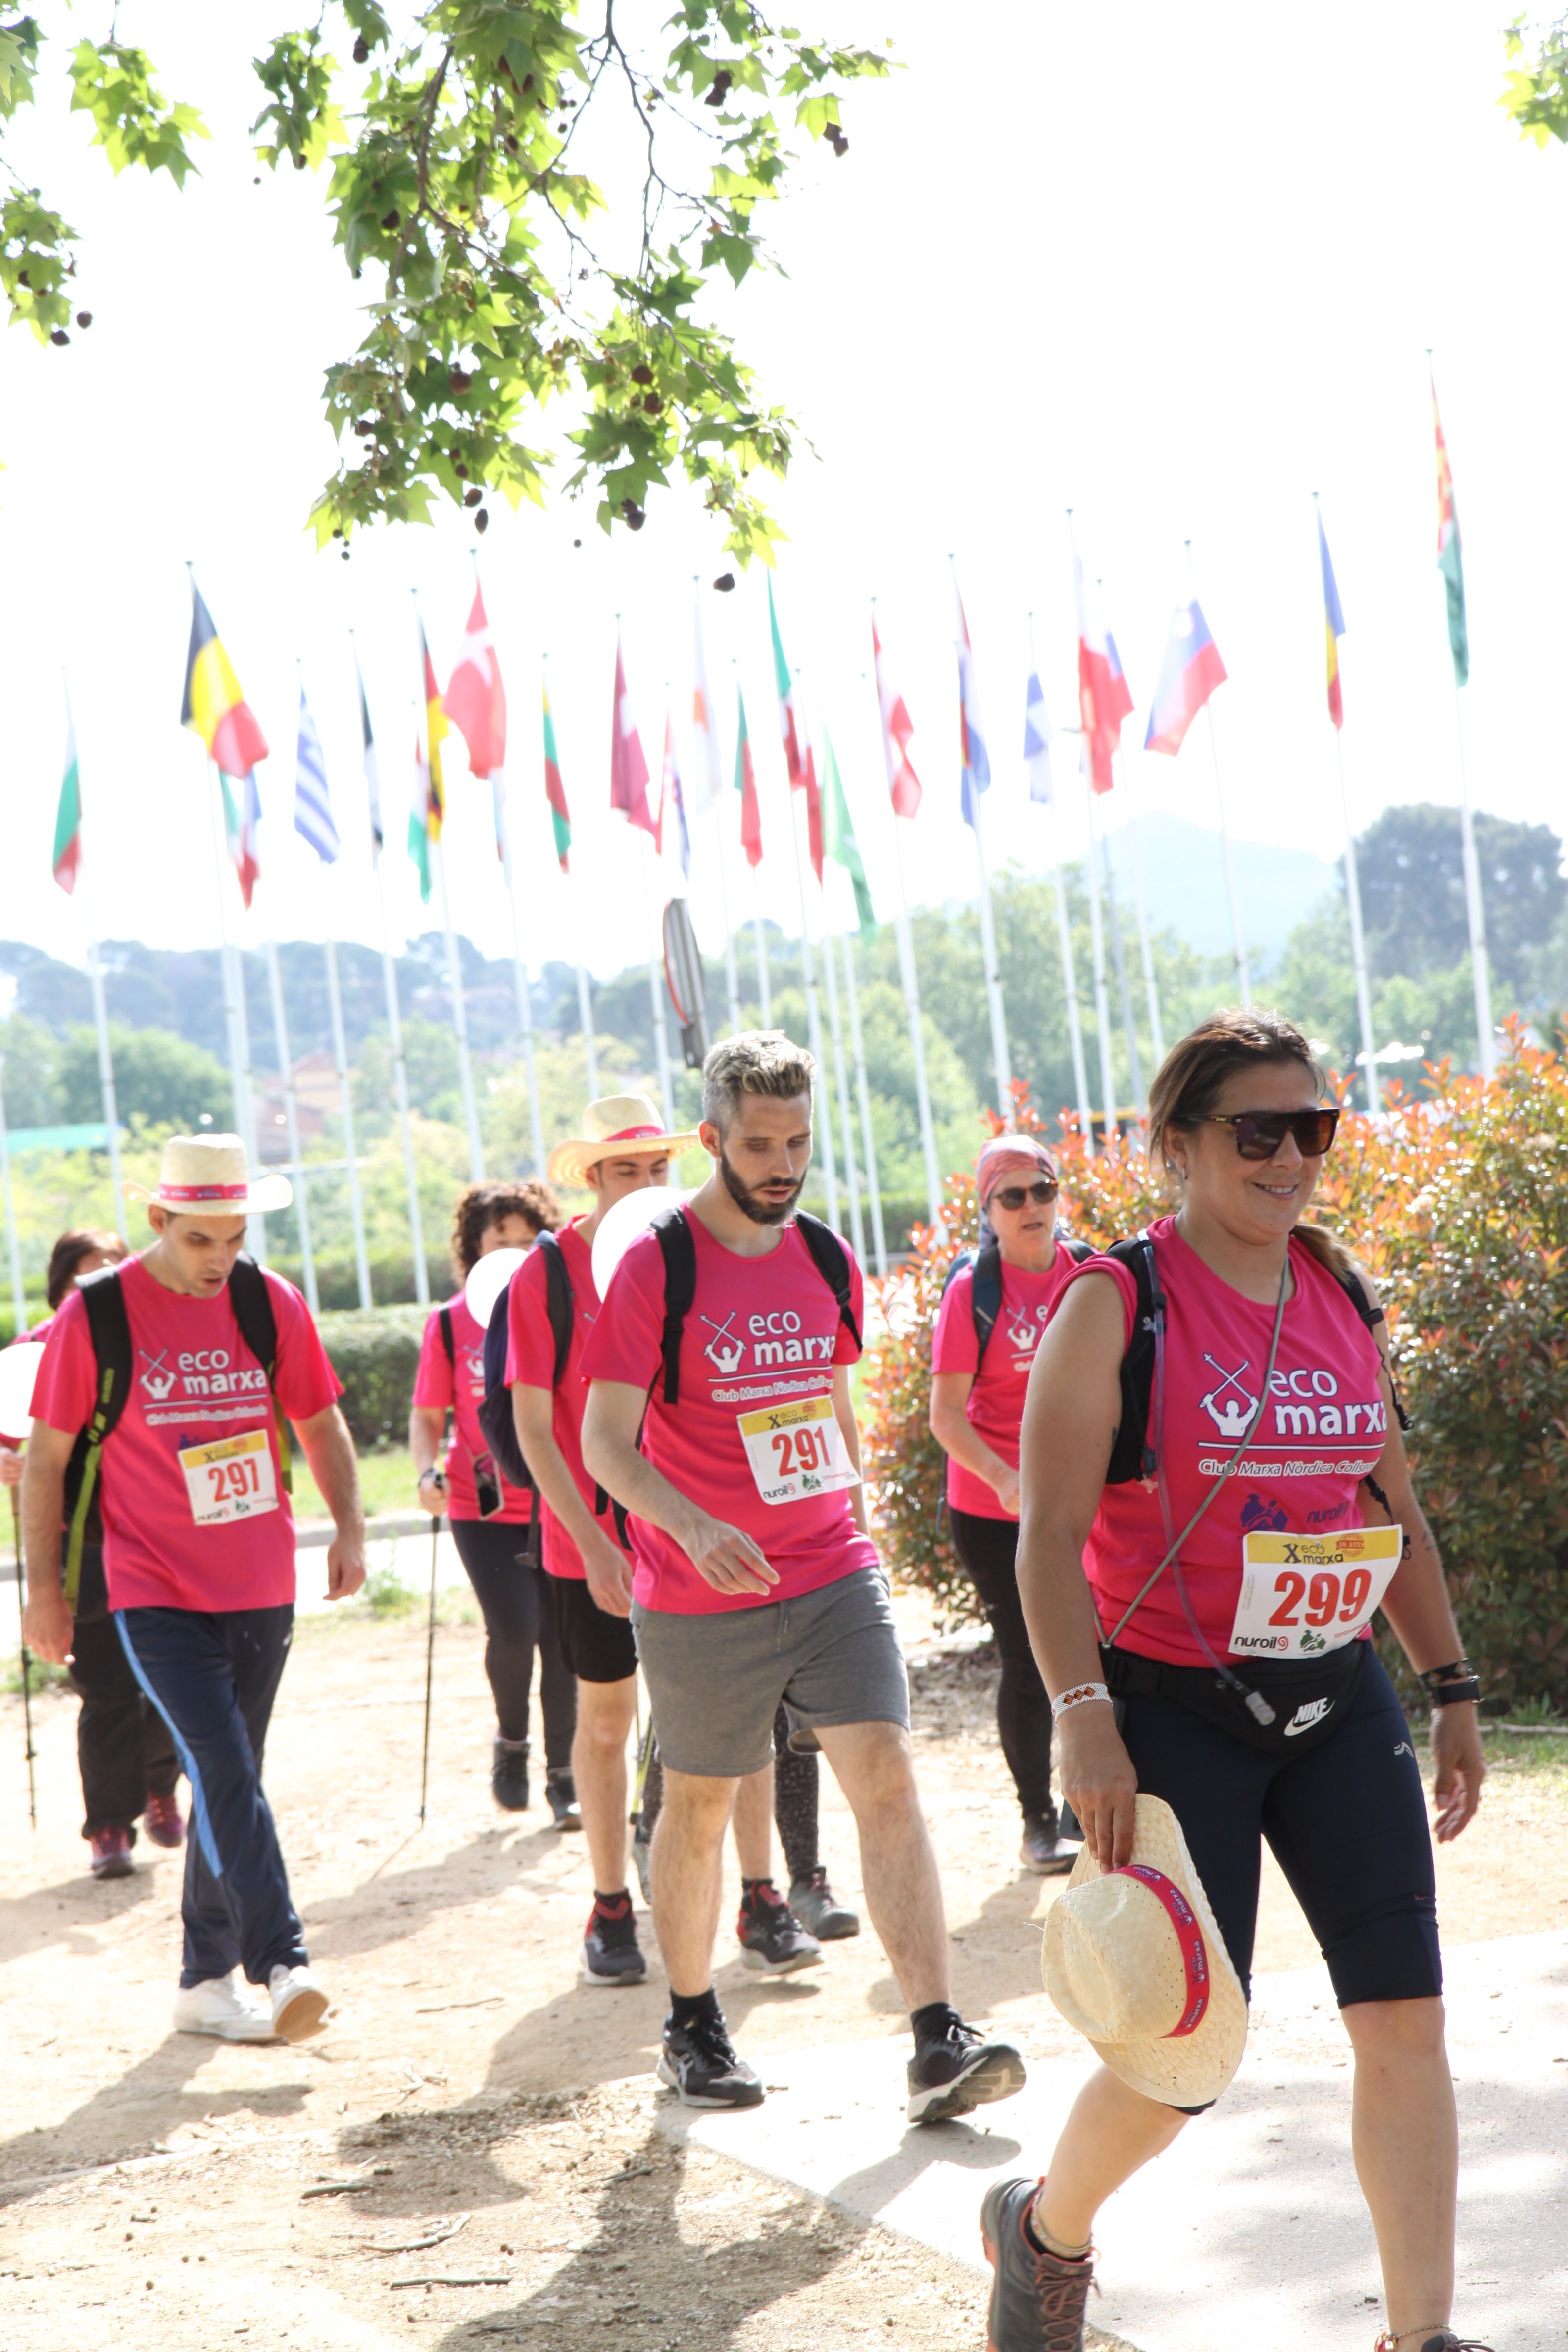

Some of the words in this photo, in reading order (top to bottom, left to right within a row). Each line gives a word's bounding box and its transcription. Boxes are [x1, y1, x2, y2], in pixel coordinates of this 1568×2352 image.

[748, 1311, 801, 1337] eco
[178, 1349, 230, 1372] eco
[182, 1369, 267, 1395] marxa
[713, 1389, 739, 1402] Club
[740, 1386, 773, 1400] Marxa
[1266, 1369, 1338, 1398] eco
[768, 1414, 782, 1430] X
[782, 1415, 809, 1427] marxa
[780, 1410, 797, 1420] eco
[771, 1425, 831, 1477] 291
[208, 1457, 259, 1502] 297
[1238, 1461, 1281, 1476] Marxa
[1284, 1461, 1333, 1476] Nòrdica
[763, 1485, 788, 1499] nuroil
[1283, 1543, 1301, 1564] X
[1303, 1553, 1344, 1565] marxa
[1301, 1543, 1324, 1554] eco
[1268, 1568, 1372, 1627] 299
[1234, 1636, 1277, 1649] nuroil
[1293, 1697, 1328, 1724] NIKE
[1170, 1889, 1187, 1914] marxa
[1194, 1940, 1204, 1971] marxa
[1190, 1998, 1203, 2023] marxa
